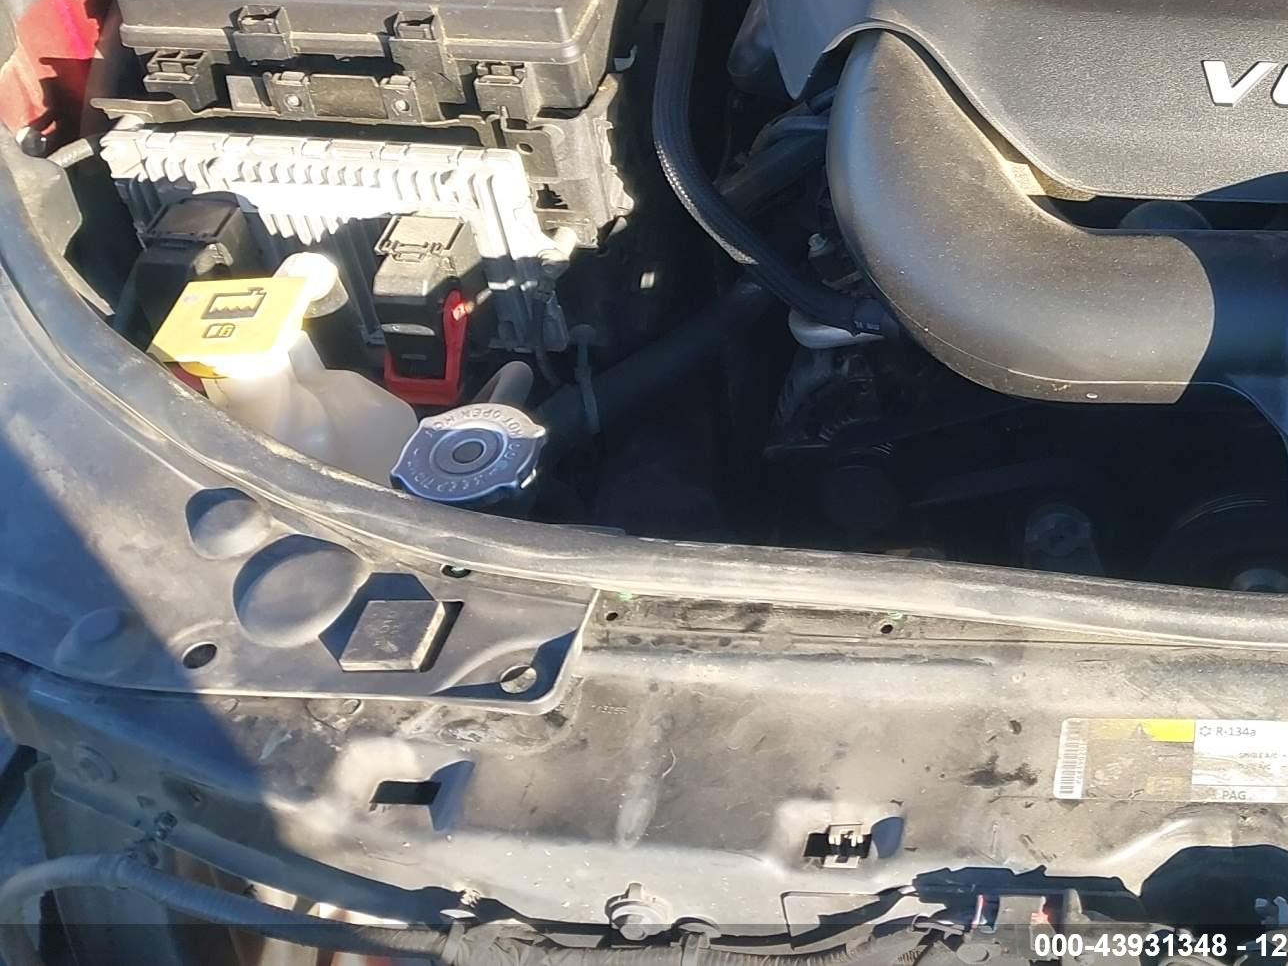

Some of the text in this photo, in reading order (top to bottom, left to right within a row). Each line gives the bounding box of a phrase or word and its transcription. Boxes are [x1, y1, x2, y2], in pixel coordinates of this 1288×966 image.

[461, 407, 501, 419] OPEN
[1215, 726, 1257, 737] R-134a
[1221, 790, 1248, 800] PAG
